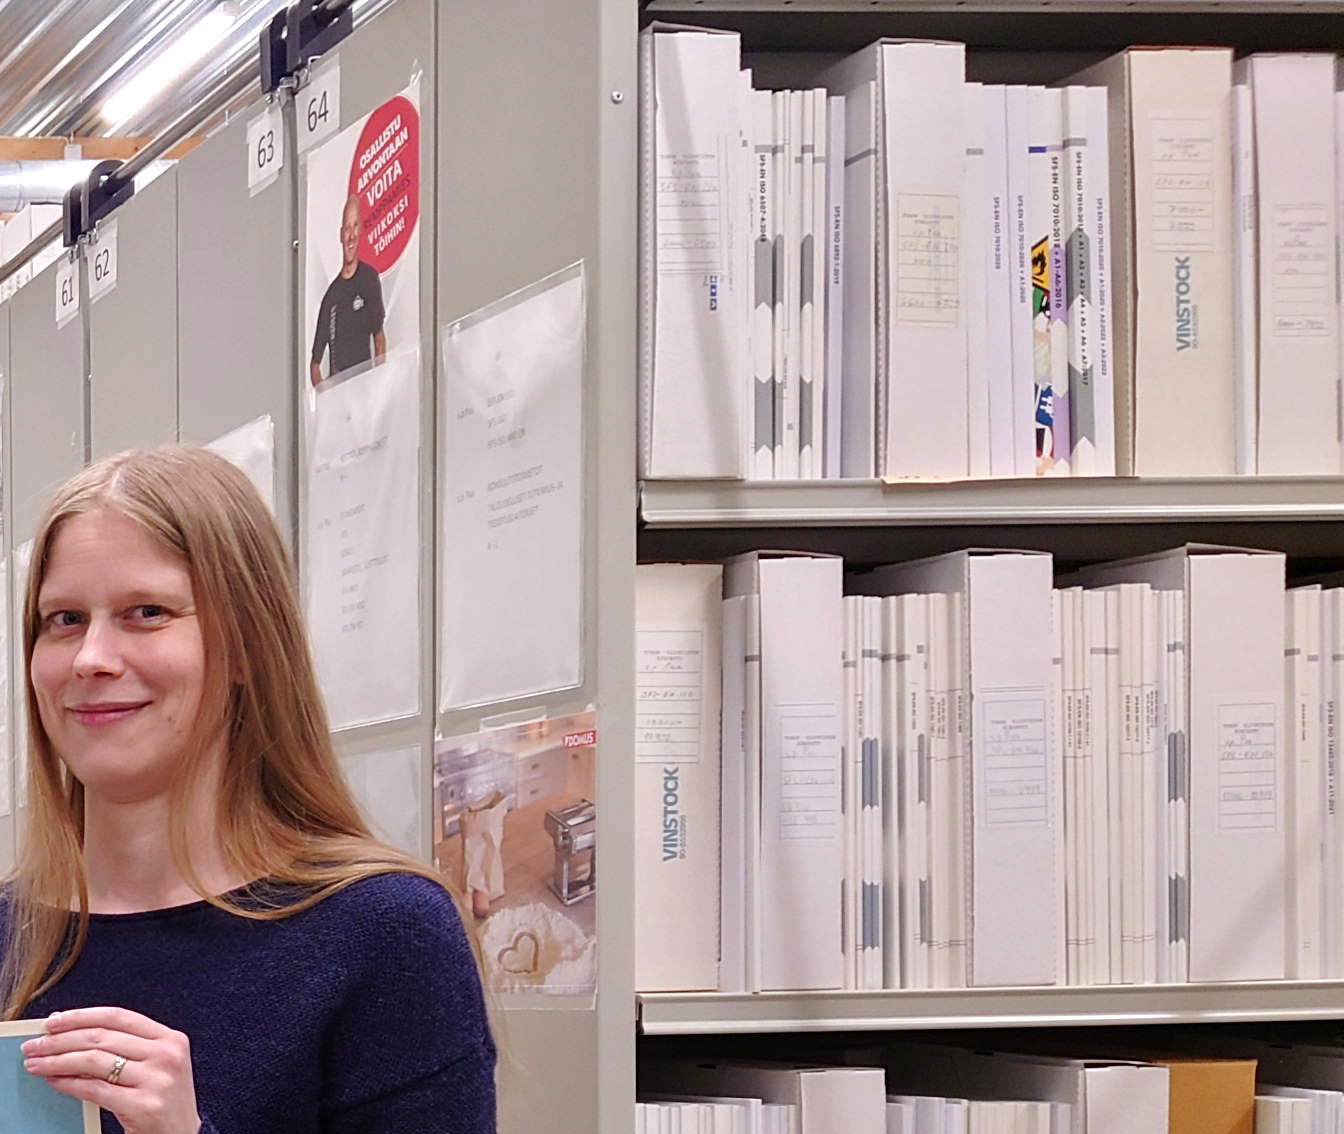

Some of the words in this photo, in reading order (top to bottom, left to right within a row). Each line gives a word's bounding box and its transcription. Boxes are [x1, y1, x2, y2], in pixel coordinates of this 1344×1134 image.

[307, 90, 329, 132] 64
[257, 130, 274, 168] 63
[359, 114, 401, 169] OSALLISTU
[357, 126, 409, 193] ARVONTAAN
[758, 154, 767, 179] SFS-EN
[1051, 156, 1059, 185] SFS-EN
[366, 159, 403, 207] VOITA
[758, 180, 767, 194] ISO
[1052, 186, 1060, 201] ISO
[367, 195, 409, 244] VIIKOKSI
[993, 196, 1001, 220] SFS-EN
[1017, 219, 1025, 232] ISO
[374, 217, 405, 256] TÖIHIN!
[1097, 222, 1105, 236] ISO
[94, 249, 110, 281] 62
[61, 277, 74, 306] 61
[1174, 256, 1192, 352] VINSTOCK
[662, 766, 679, 862] VINSTOCK
